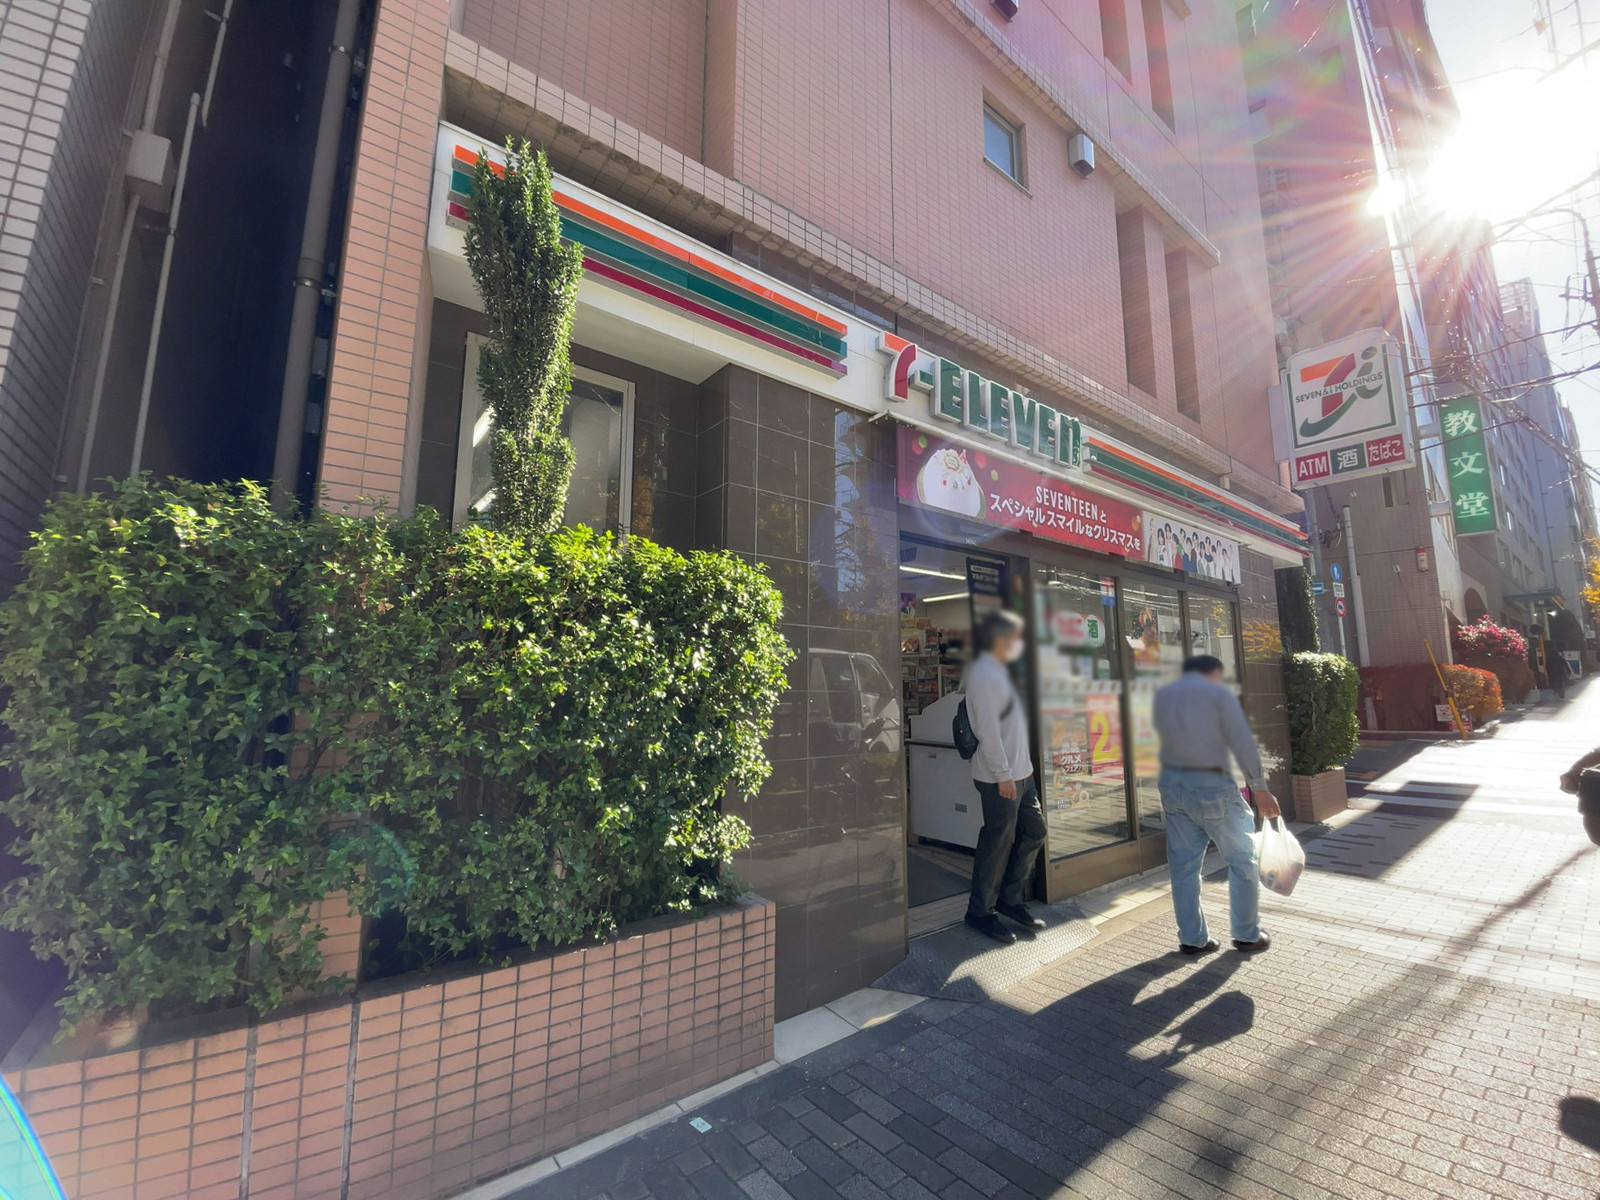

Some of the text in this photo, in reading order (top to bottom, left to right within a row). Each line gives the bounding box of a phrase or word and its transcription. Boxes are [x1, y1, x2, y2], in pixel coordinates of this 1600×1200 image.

[1335, 372, 1383, 392] HOLDINGS
[1337, 448, 1359, 470] 酒
[1368, 440, 1403, 463] たばこ
[1298, 456, 1328, 477] ATM
[1443, 409, 1490, 519] 教文堂
